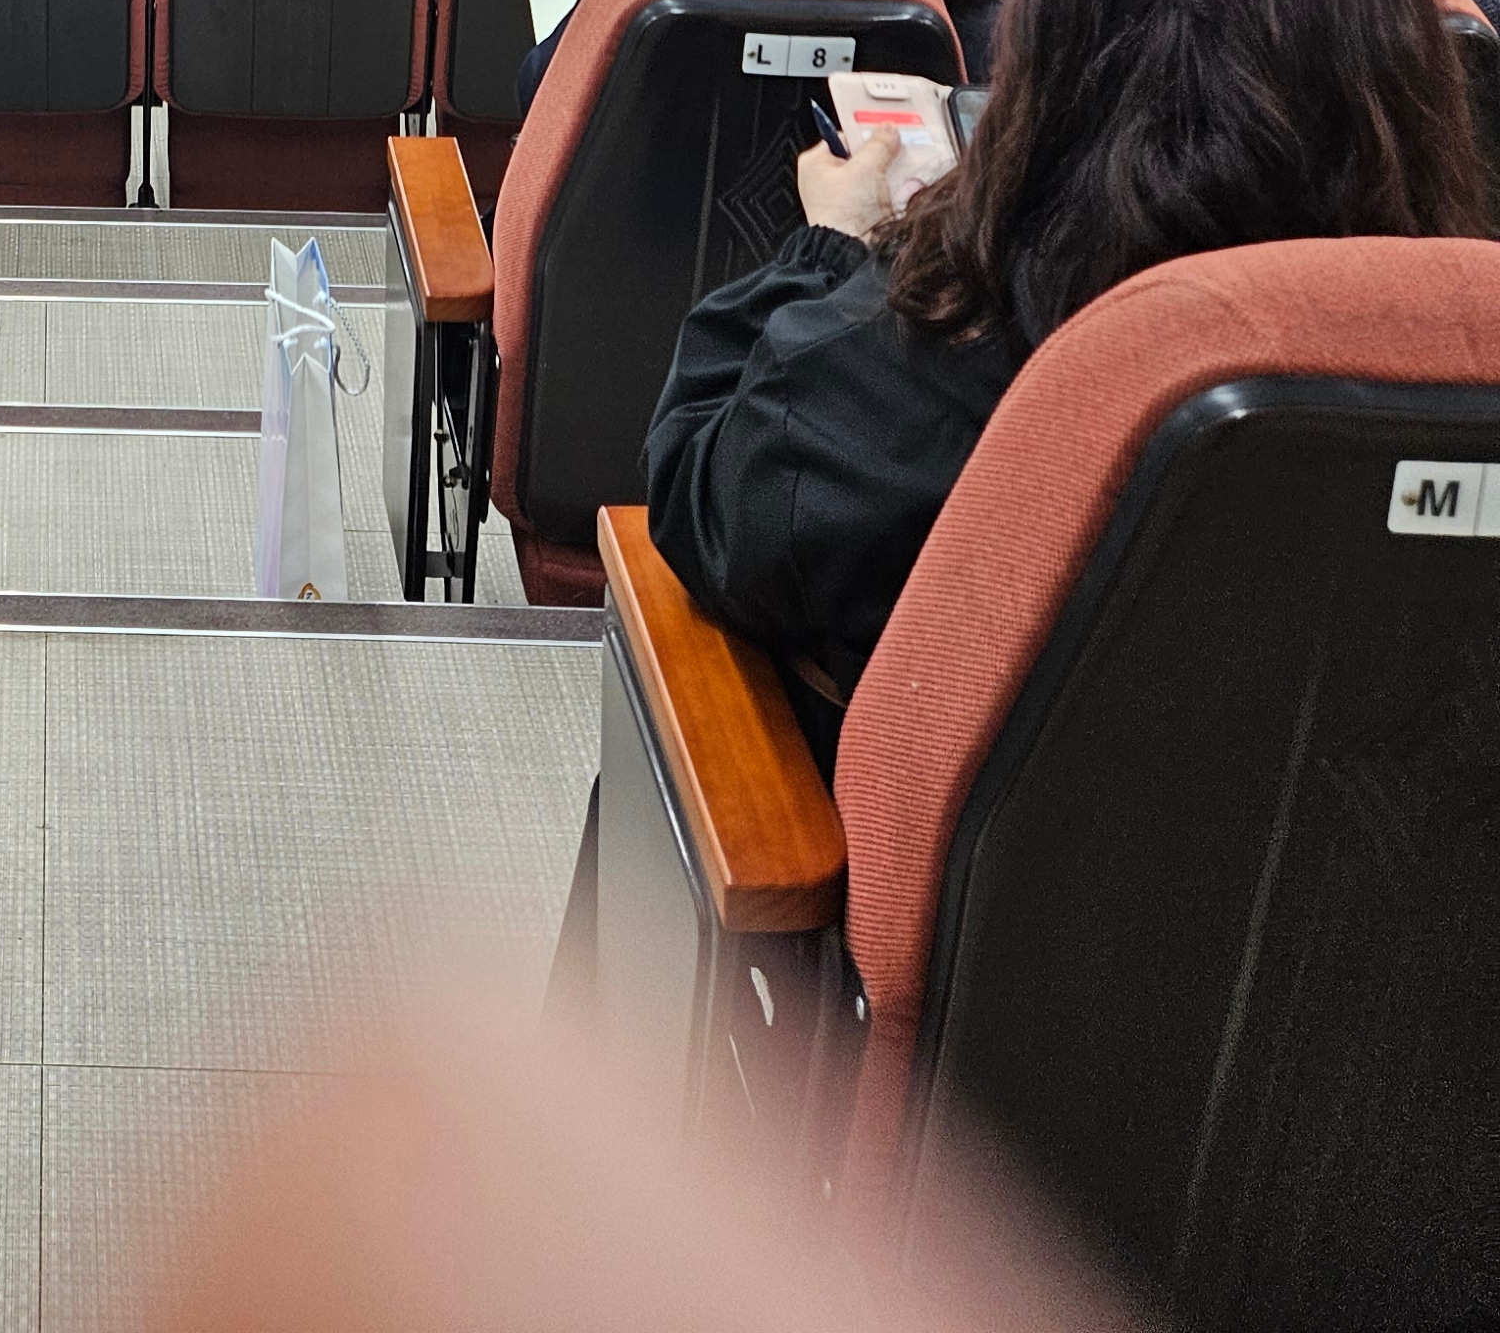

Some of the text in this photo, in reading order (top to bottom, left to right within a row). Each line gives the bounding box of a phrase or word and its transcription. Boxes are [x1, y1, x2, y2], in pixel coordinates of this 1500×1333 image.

[756, 44, 827, 69] L 8
[1417, 479, 1461, 518] M
